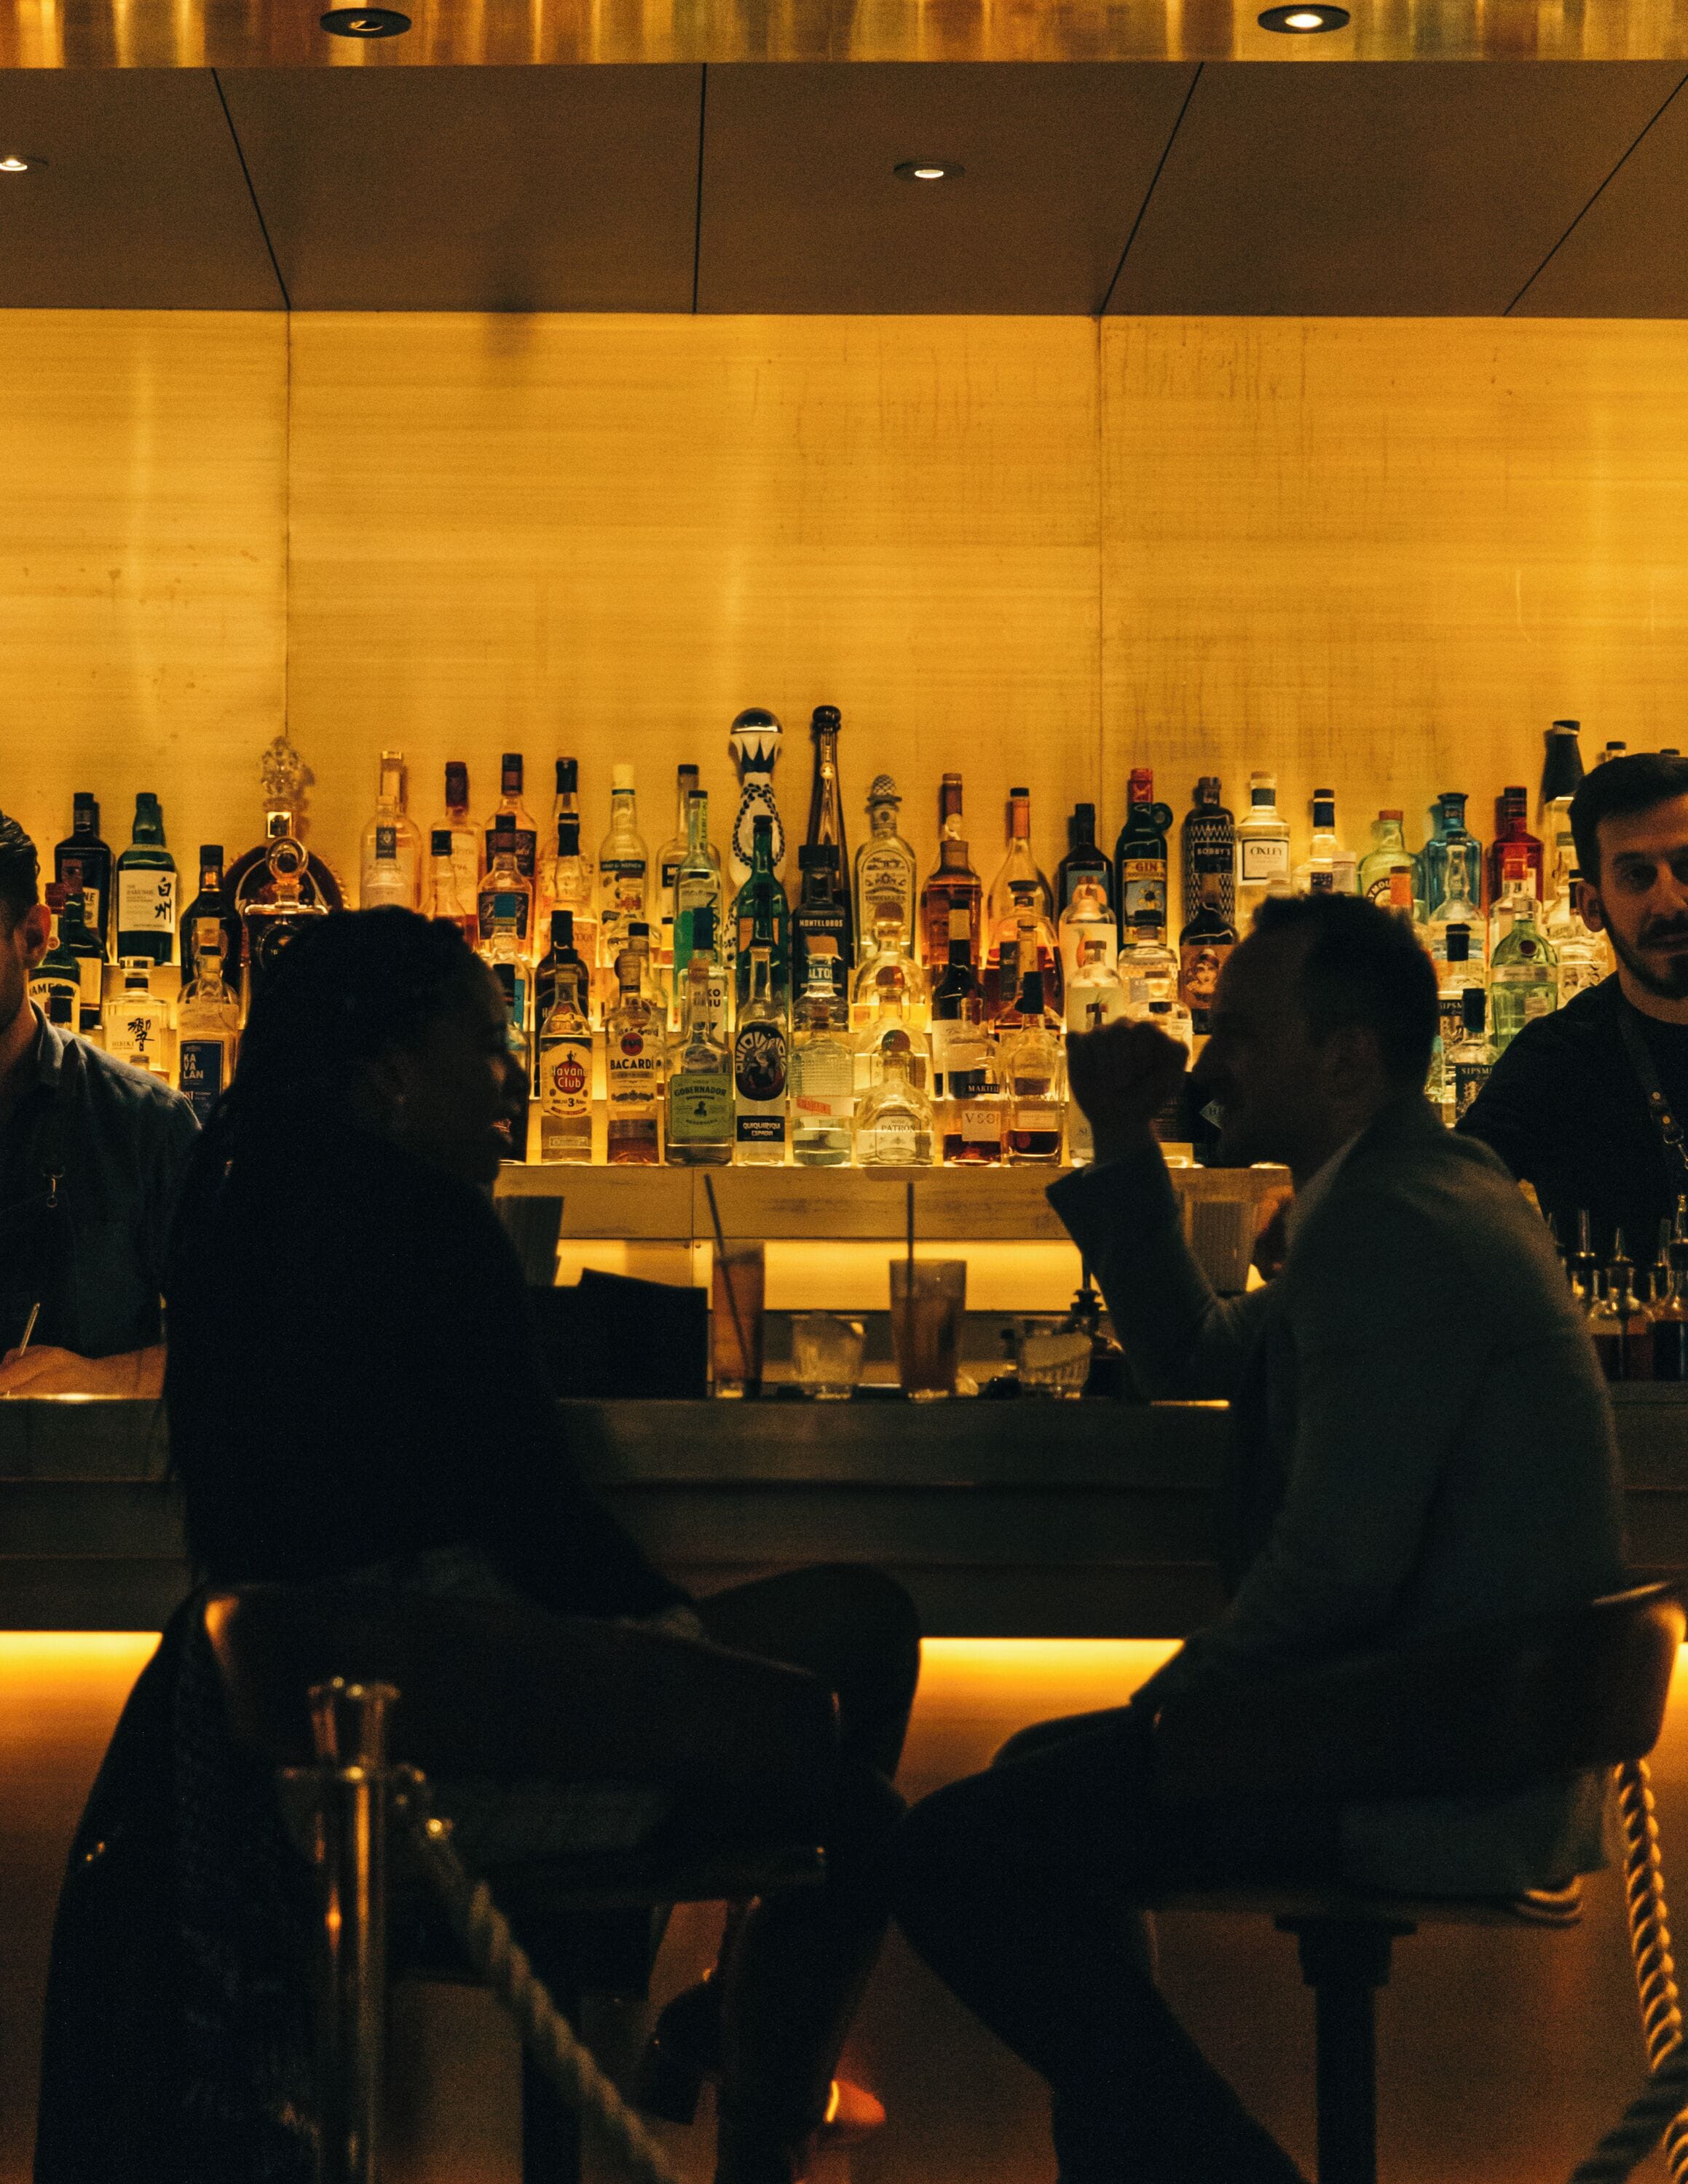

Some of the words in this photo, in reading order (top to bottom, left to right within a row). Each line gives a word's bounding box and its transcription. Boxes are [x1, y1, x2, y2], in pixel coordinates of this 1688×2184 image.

[1250, 846, 1282, 856] OXLEY
[1135, 863, 1158, 871] GIN
[154, 877, 172, 924] 白州
[184, 1070, 205, 1079] LAN
[558, 1077, 581, 1088] Club
[674, 1085, 727, 1097] GOBERNADOR
[568, 1098, 575, 1107] 3
